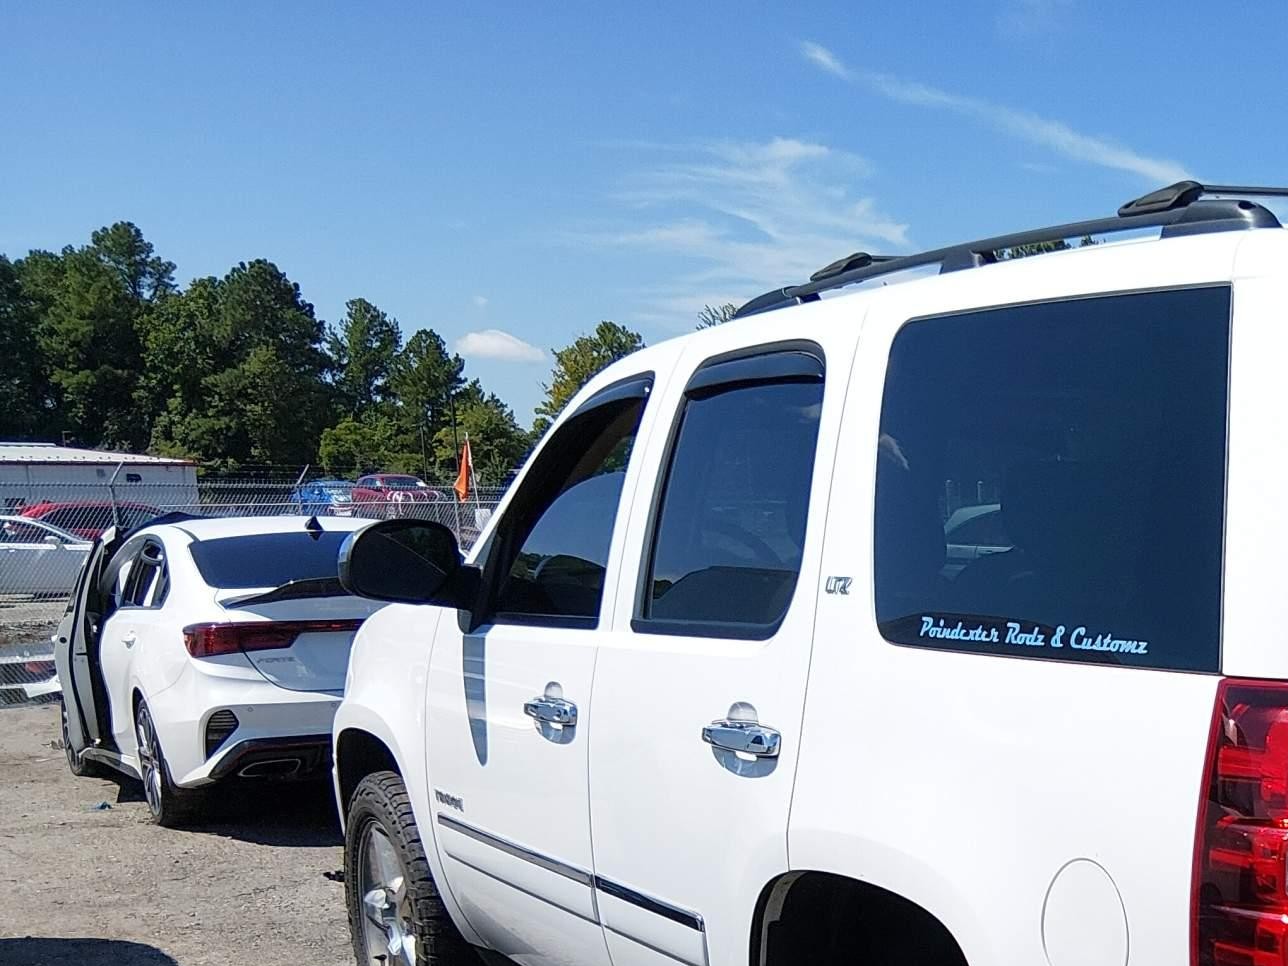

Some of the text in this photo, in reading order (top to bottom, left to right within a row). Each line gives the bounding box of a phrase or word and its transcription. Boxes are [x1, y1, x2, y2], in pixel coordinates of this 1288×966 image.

[919, 616, 1148, 654] Poindexter Rodz & Customz
